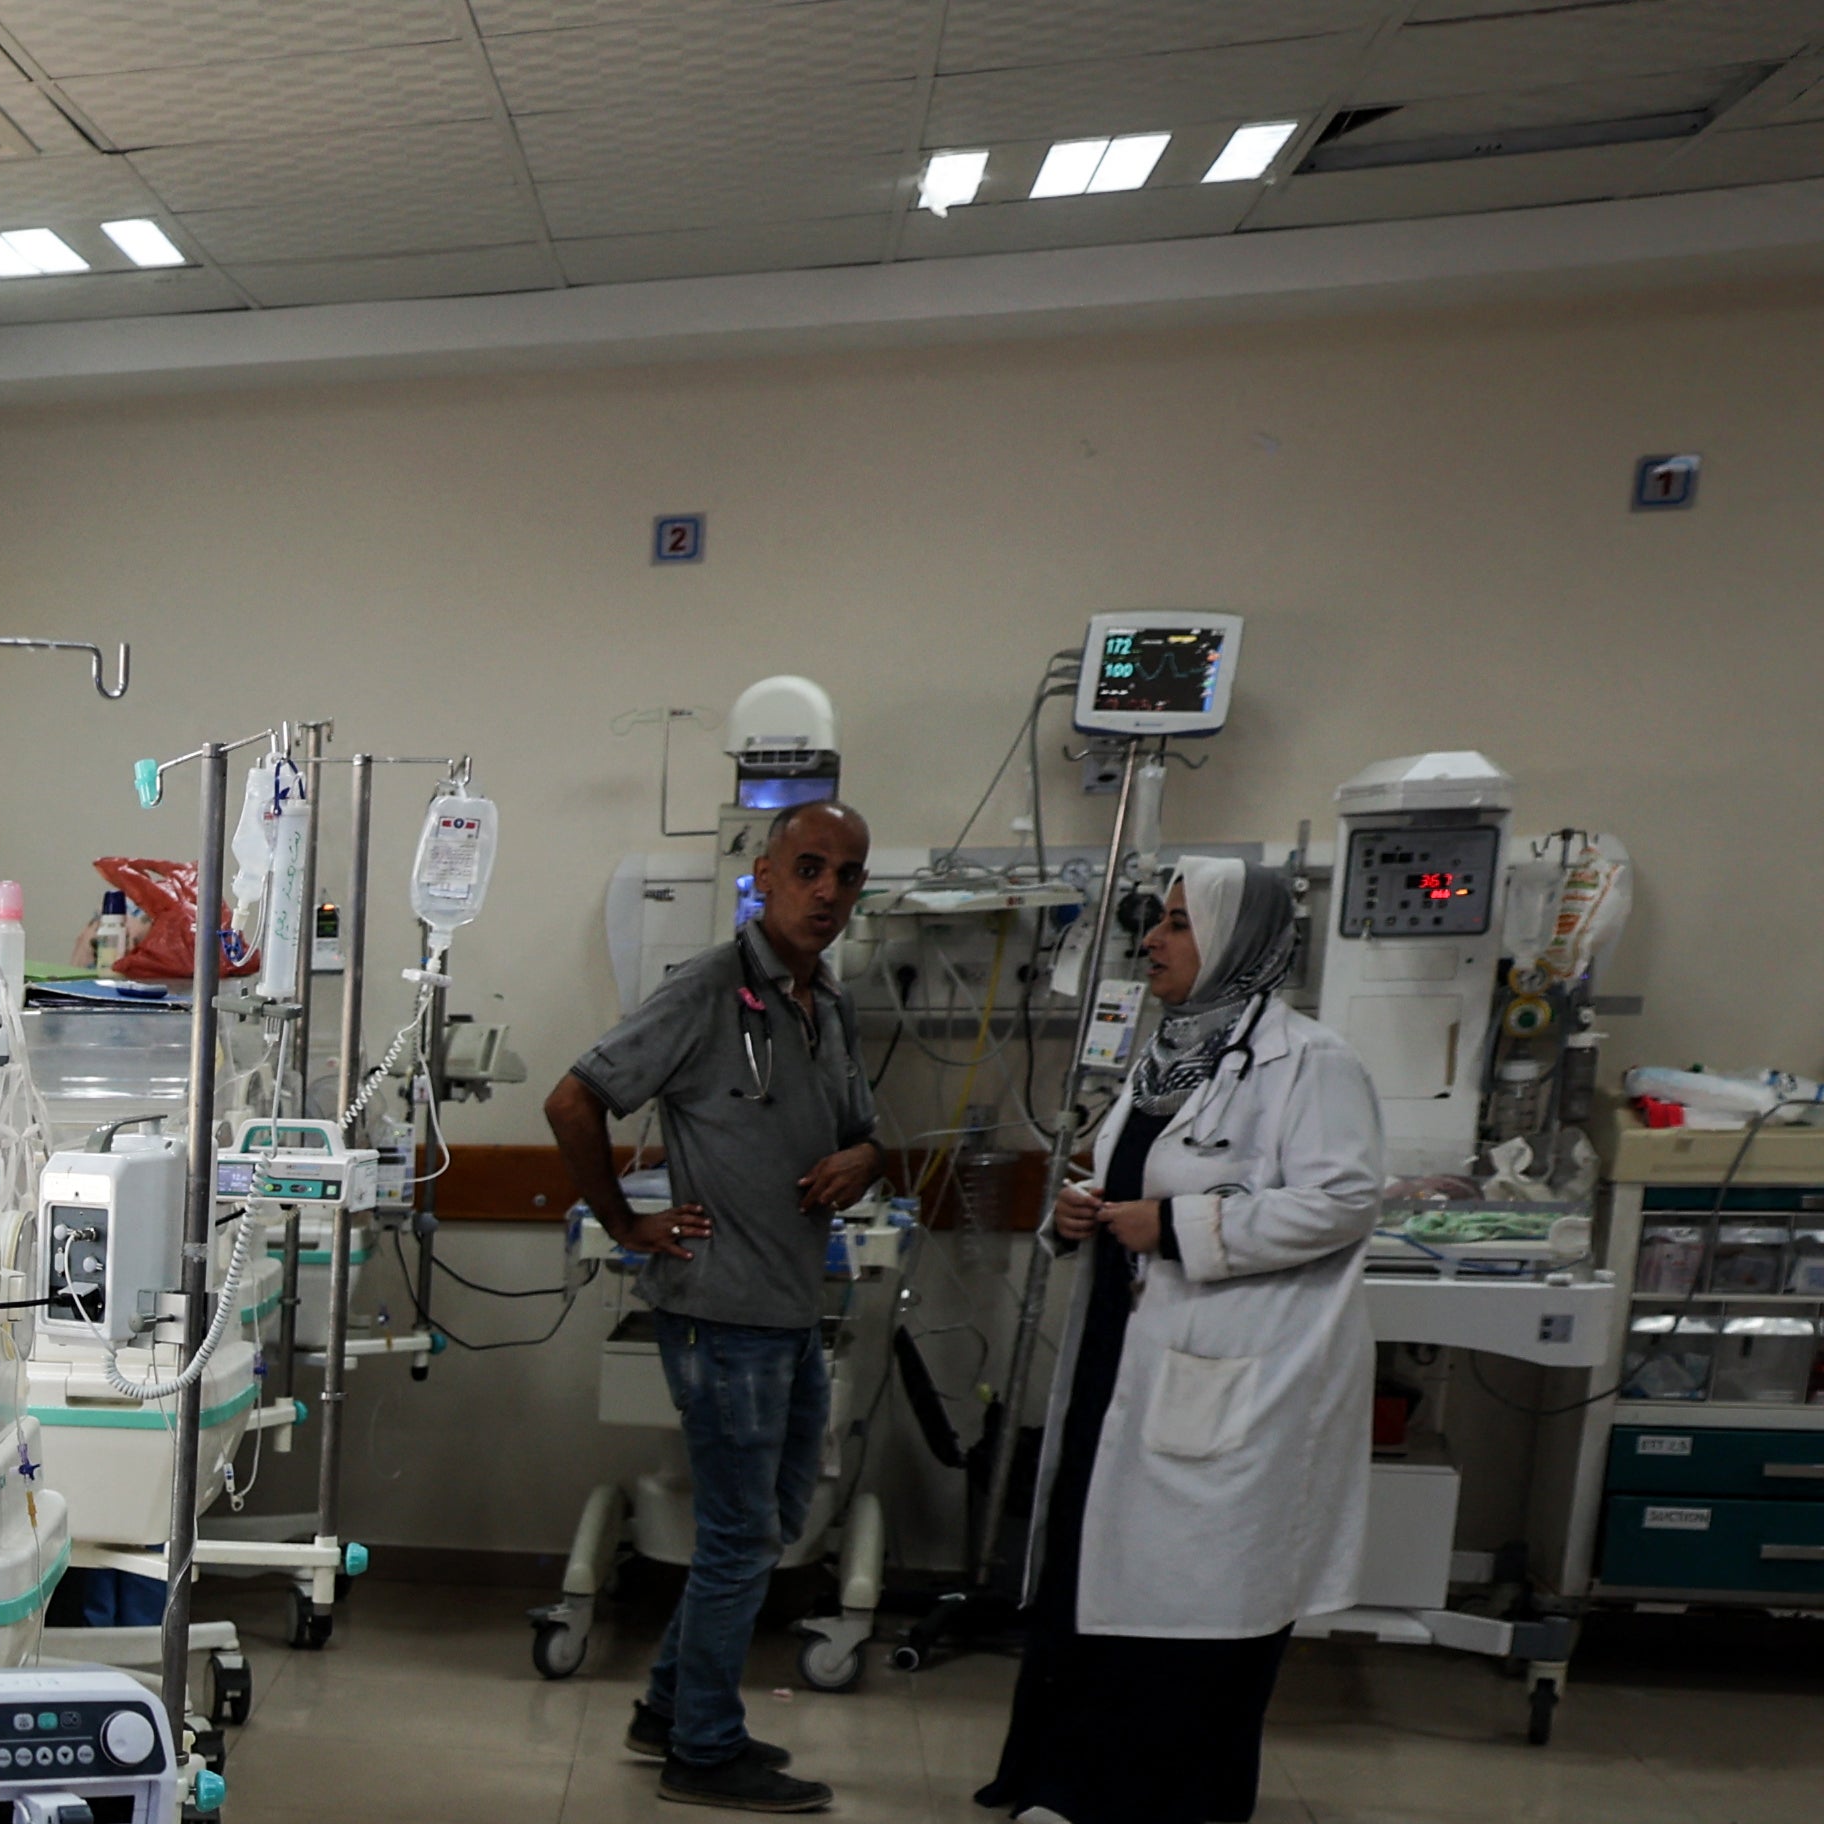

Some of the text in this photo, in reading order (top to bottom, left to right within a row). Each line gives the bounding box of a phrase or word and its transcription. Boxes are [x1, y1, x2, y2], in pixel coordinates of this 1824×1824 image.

[1655, 469, 1675, 497] 1
[669, 525, 688, 553] 2
[1105, 635, 1133, 656] 172
